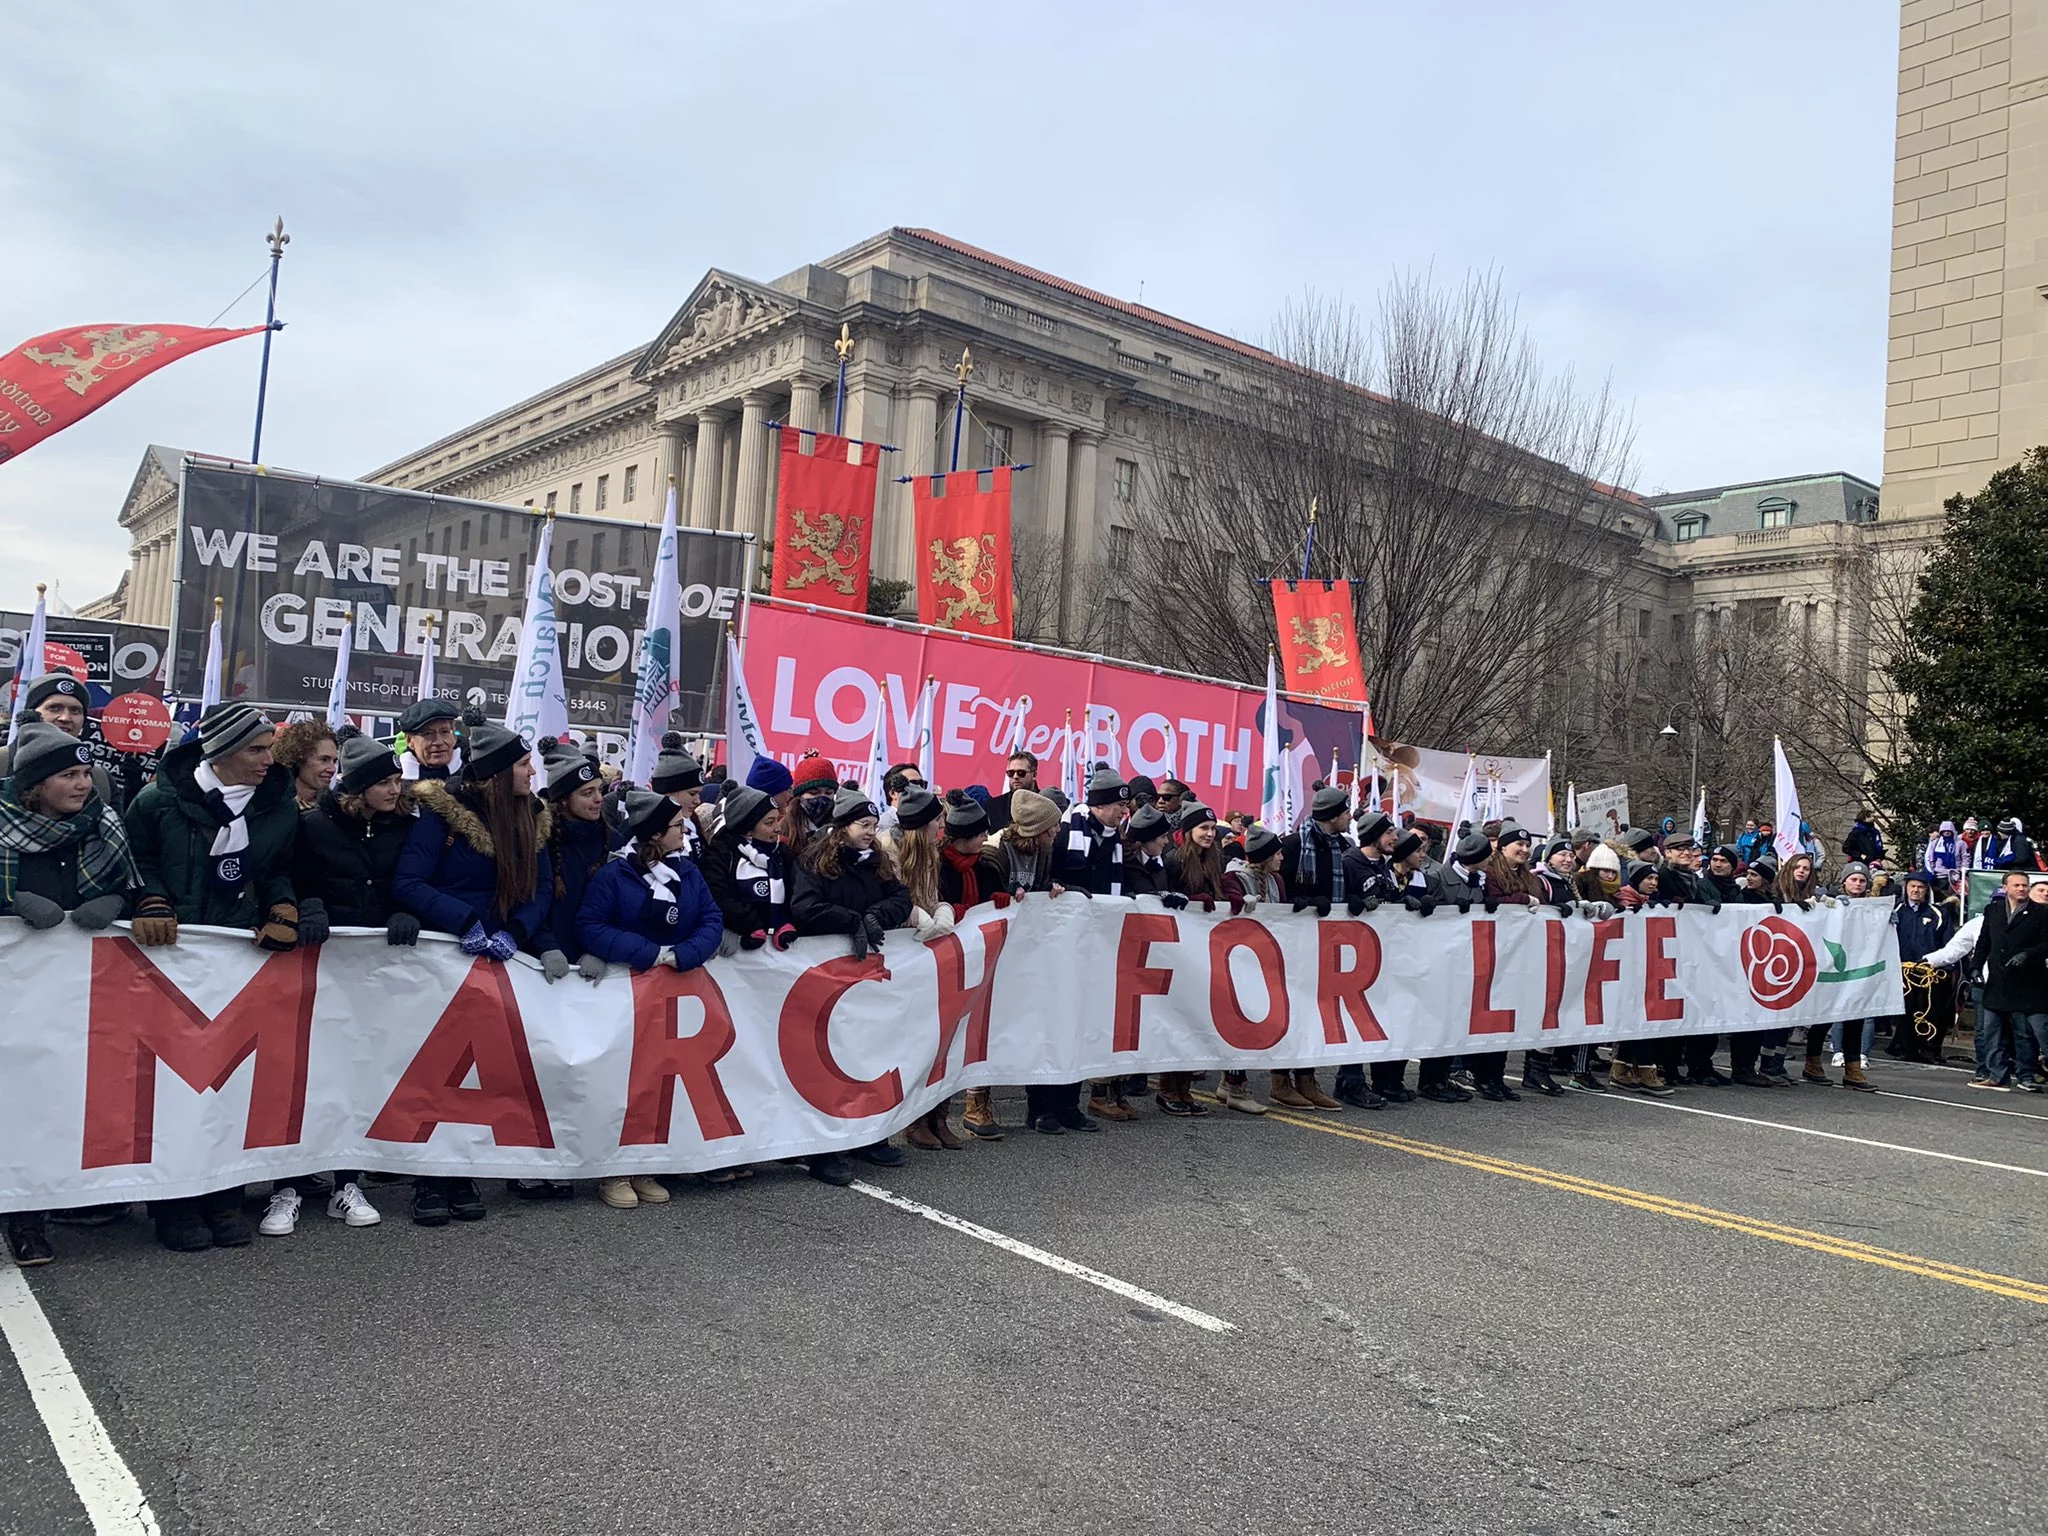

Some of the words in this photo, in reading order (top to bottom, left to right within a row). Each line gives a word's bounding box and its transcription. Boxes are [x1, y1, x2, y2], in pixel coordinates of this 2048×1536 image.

[189, 525, 278, 573] WE
[294, 540, 401, 586] ARE
[417, 553, 510, 598] THE
[102, 715, 131, 725] EVERY
[133, 718, 171, 728] WOMAN
[124, 696, 138, 705] We
[140, 698, 154, 706] are
[128, 707, 148, 716] FOR
[570, 698, 607, 712] 53445
[771, 656, 980, 757] LOVE
[1085, 703, 1251, 791] BOTH
[82, 918, 1008, 1170] MARCH
[1113, 913, 1388, 1053] FOR
[1469, 916, 1685, 1036] LIFE
